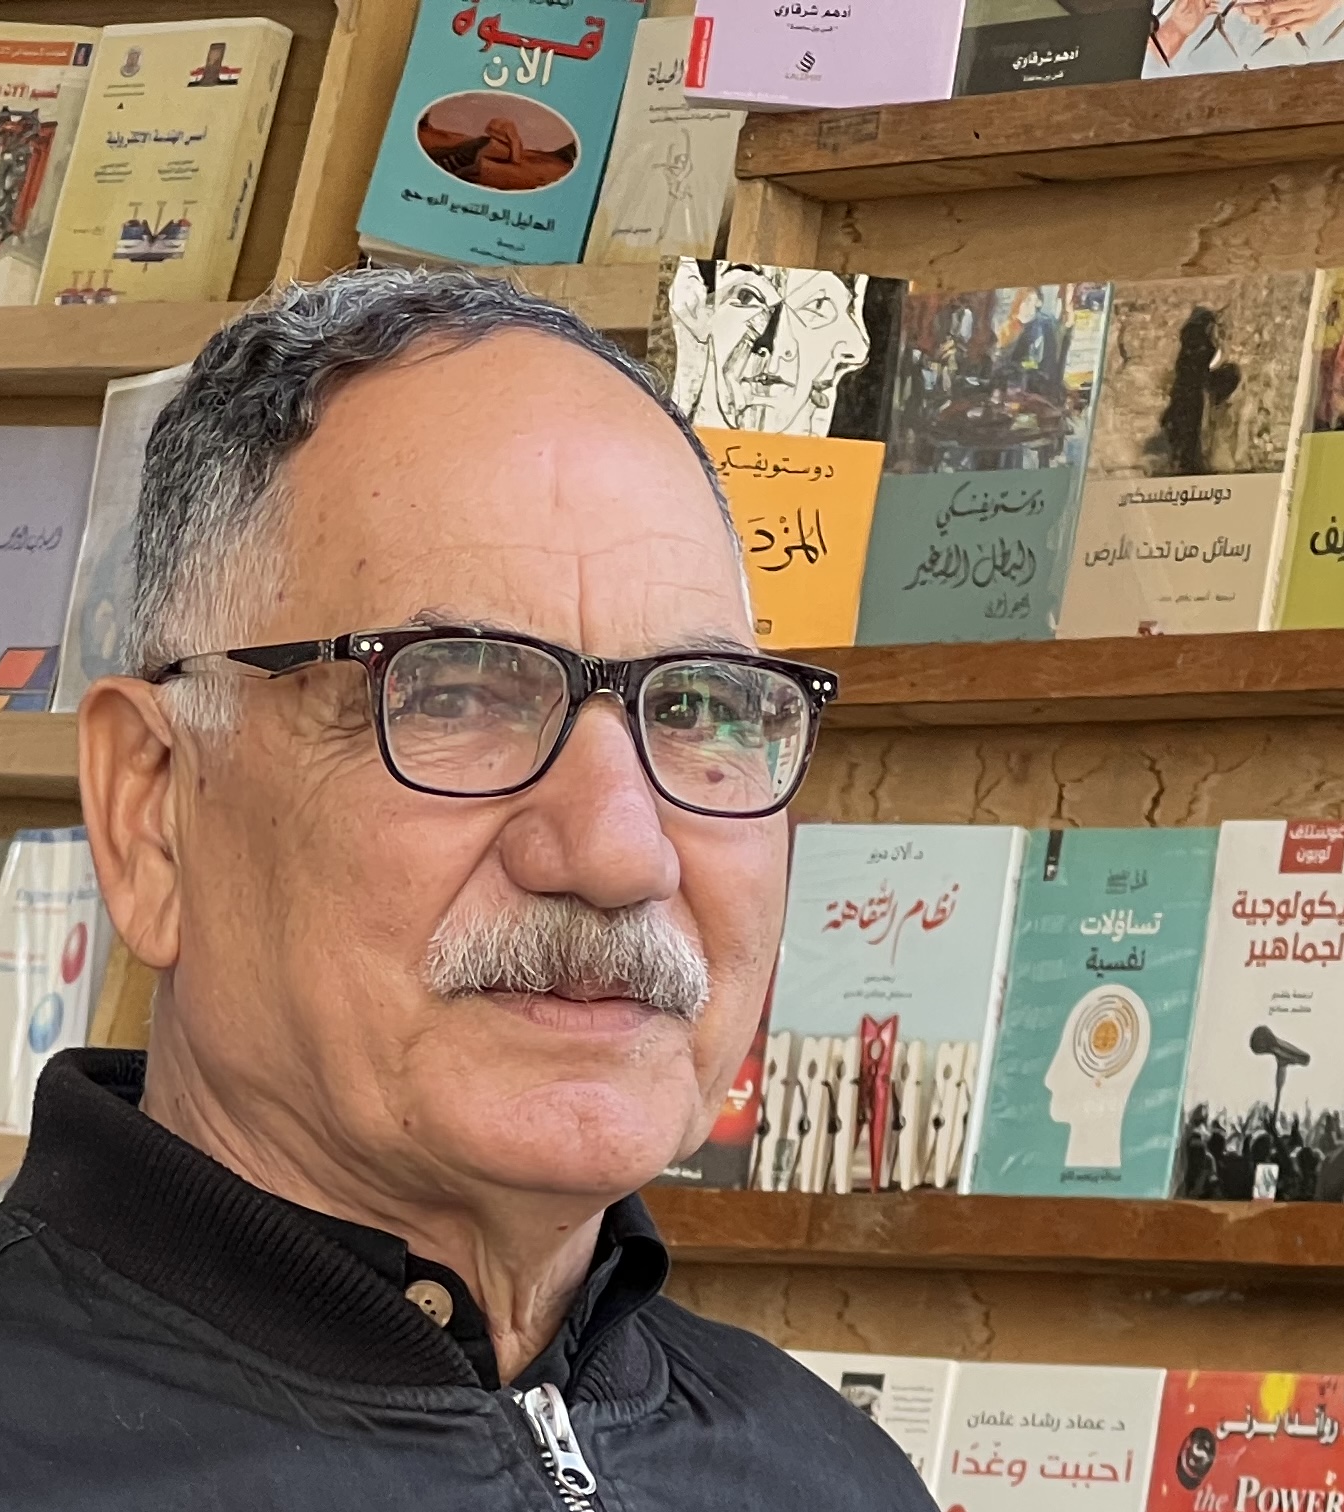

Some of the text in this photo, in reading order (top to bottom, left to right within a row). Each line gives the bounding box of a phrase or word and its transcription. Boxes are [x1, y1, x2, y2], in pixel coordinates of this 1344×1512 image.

[1117, 485, 1233, 508] دوستويفسكي
[1136, 538, 1172, 560] تحت
[1171, 542, 1200, 563] من
[1202, 538, 1252, 563] رسائل
[892, 882, 961, 967] نظام
[1079, 908, 1163, 943] تساؤلات
[1084, 945, 1147, 978] نفسية
[966, 1410, 1106, 1433] عماد رشاد عثمان
[1039, 1447, 1134, 1489] أحببت
